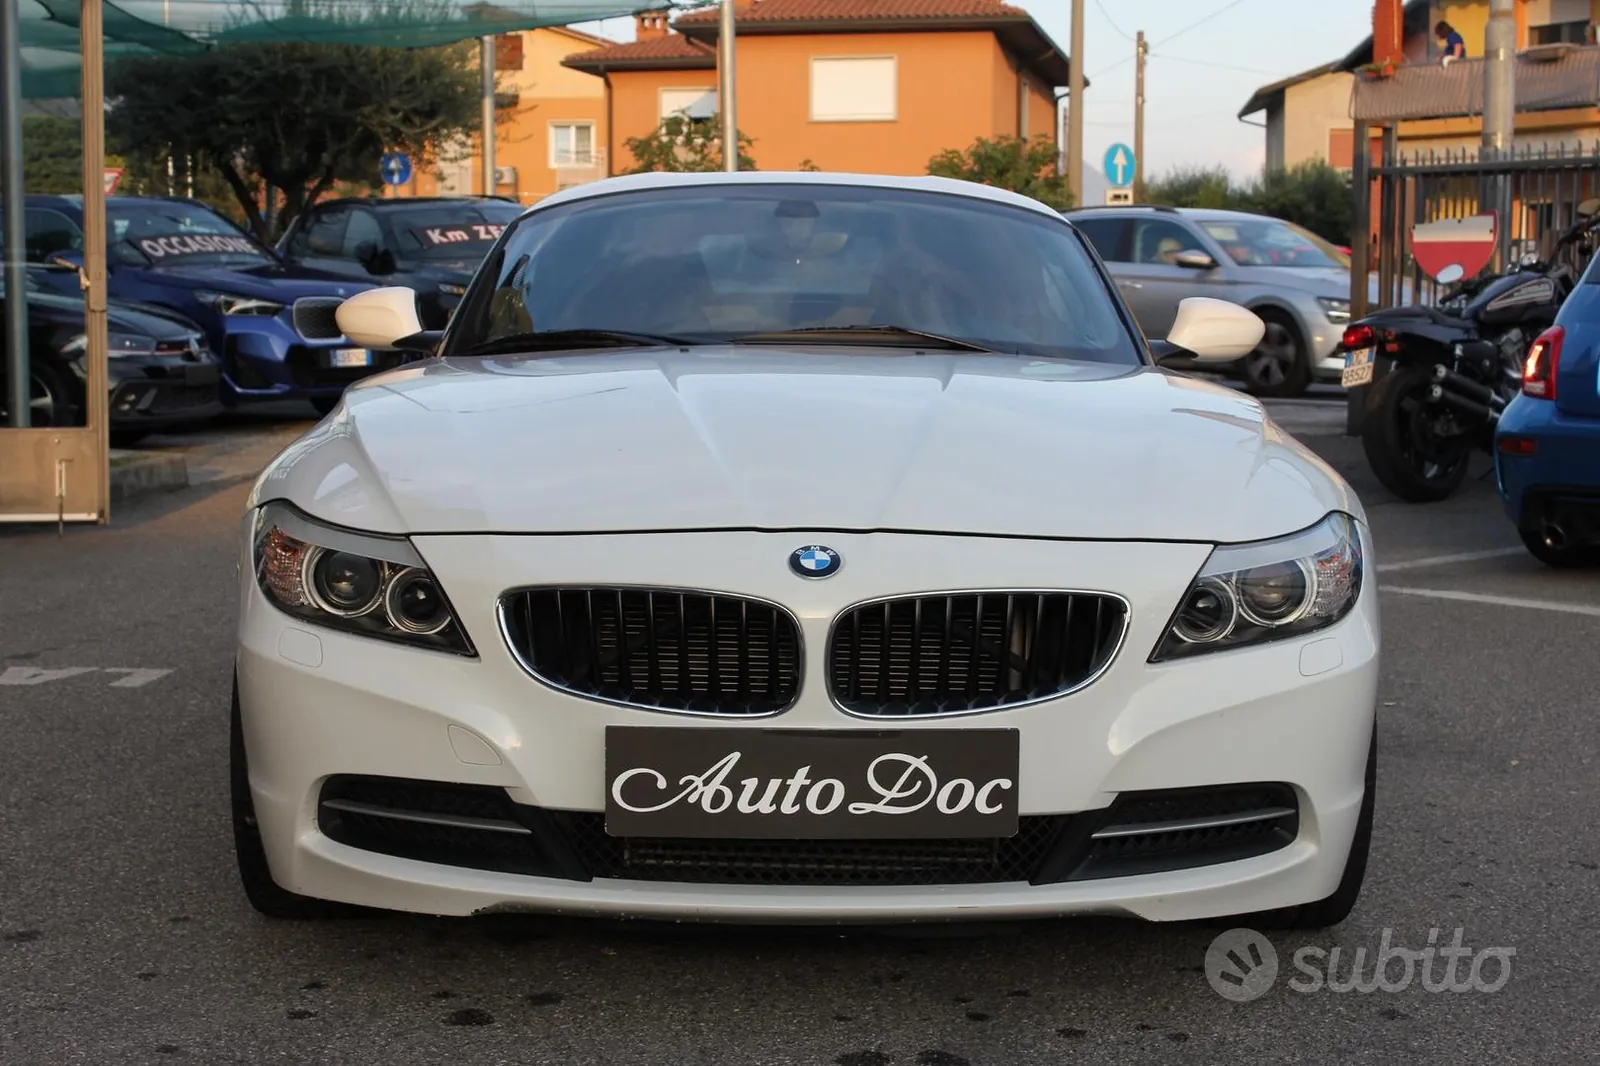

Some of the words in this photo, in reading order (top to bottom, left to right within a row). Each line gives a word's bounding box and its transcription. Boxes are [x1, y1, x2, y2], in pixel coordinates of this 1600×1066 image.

[426, 228, 470, 244] Km
[472, 225, 506, 240] ZE
[611, 751, 846, 815] Auto
[848, 753, 1013, 815] Doc
